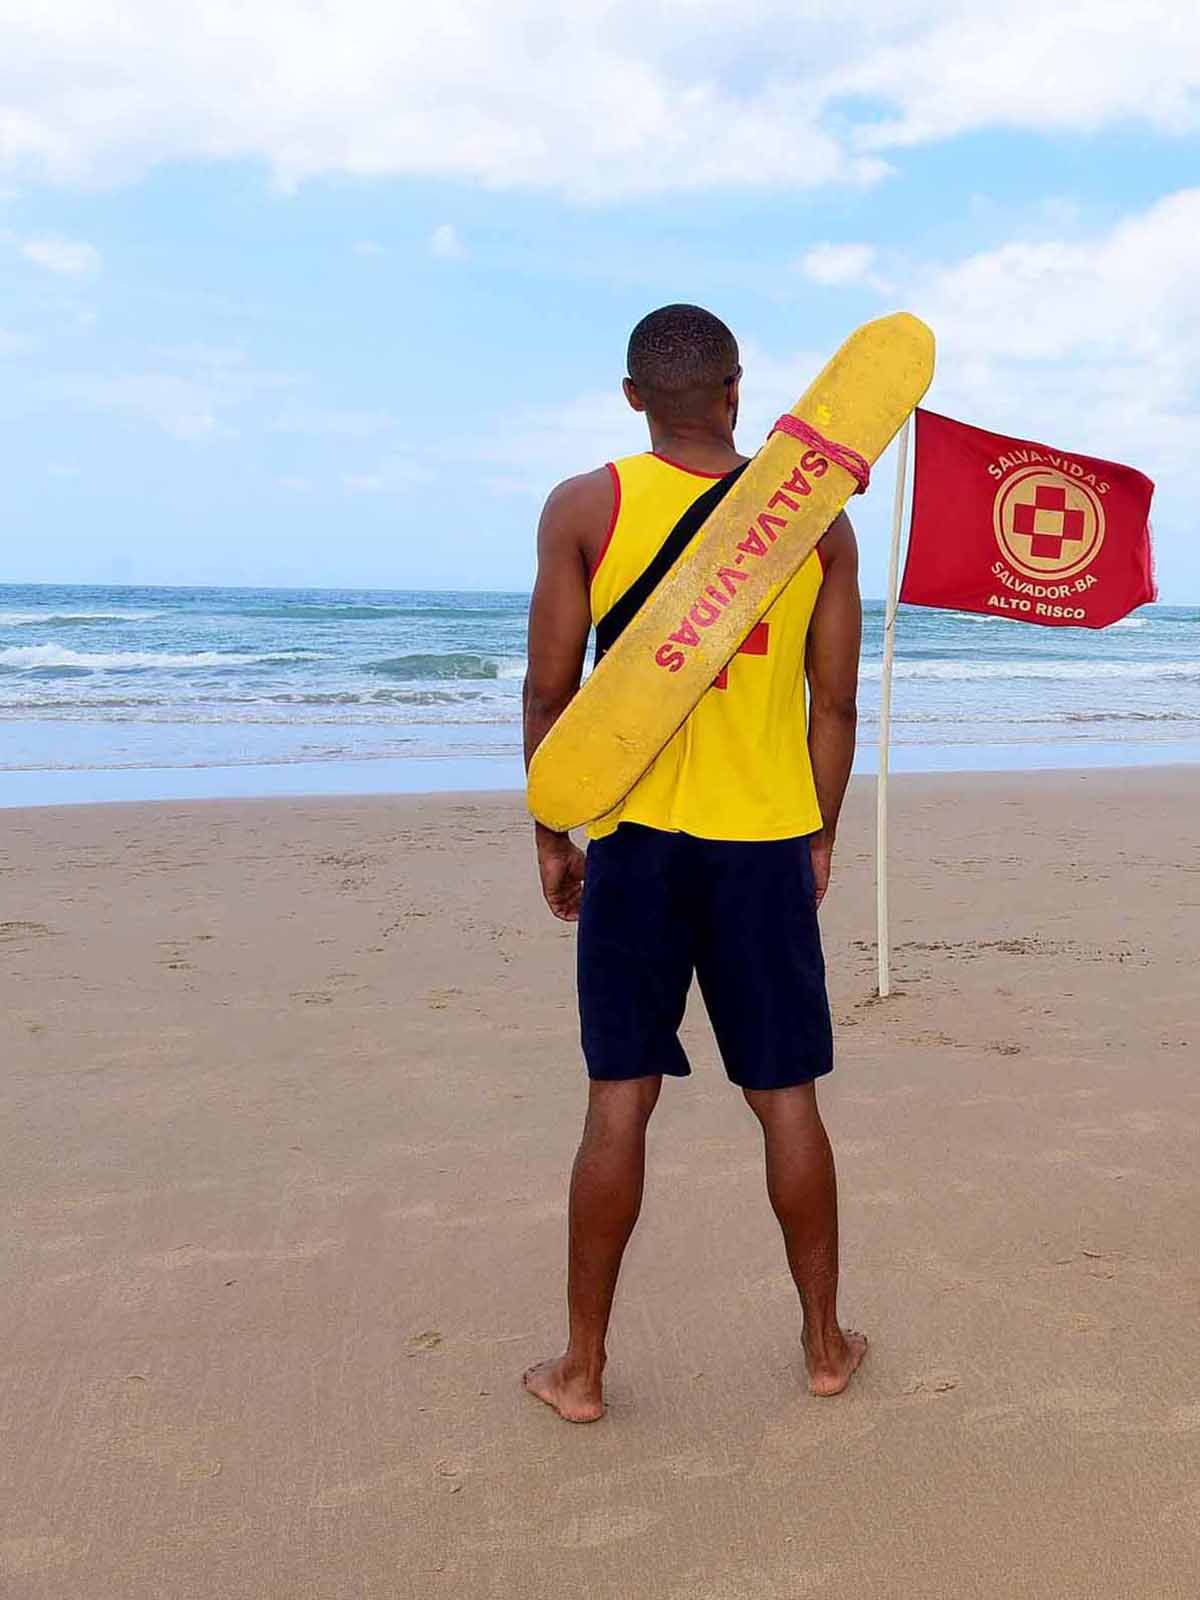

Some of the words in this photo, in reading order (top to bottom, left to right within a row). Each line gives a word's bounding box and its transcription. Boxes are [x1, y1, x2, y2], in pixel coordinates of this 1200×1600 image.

[988, 450, 1110, 495] SALVA-VIDAS
[655, 450, 829, 673] SALVA-VIDAS
[991, 561, 1098, 599] SALVADOR-BA
[987, 595, 1032, 611] ALTO
[1036, 602, 1086, 619] RISCO
